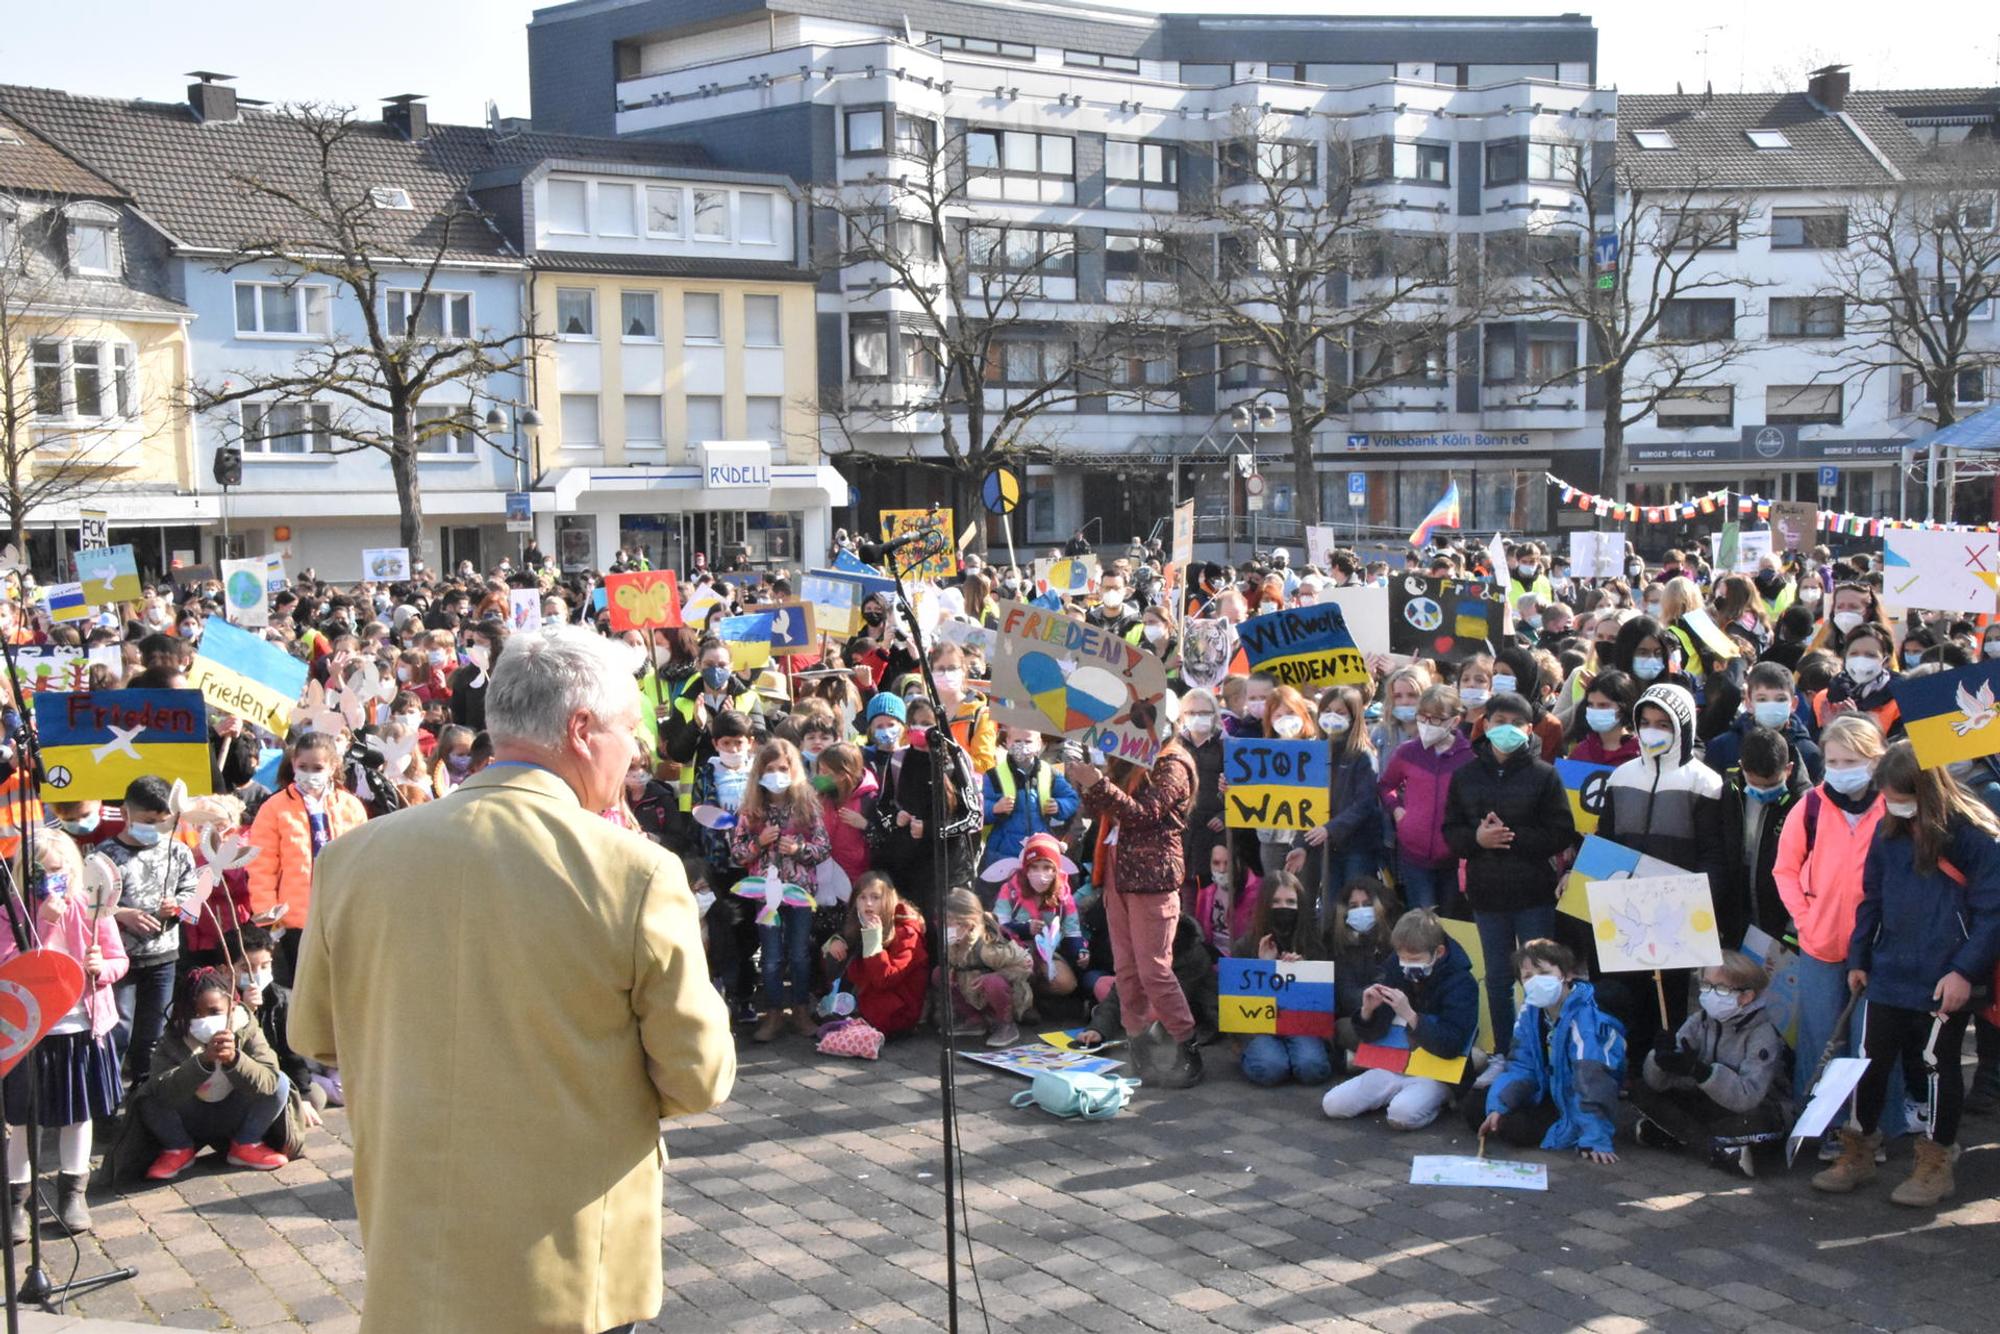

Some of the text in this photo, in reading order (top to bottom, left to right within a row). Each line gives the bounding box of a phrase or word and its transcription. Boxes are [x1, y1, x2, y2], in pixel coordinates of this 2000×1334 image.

[1372, 433, 1529, 447] Volksbank Köln Bonn eG
[711, 464, 769, 483] RÜDELL
[82, 519, 106, 538] FCK
[1004, 609, 1143, 677] FRIEDEN!
[67, 694, 194, 733] Frieden
[200, 671, 280, 725] Frieden!
[1082, 725, 1161, 765] NO WAR
[1233, 747, 1312, 783] STOP
[1231, 793, 1316, 828] WAR
[1240, 969, 1296, 992] STOP
